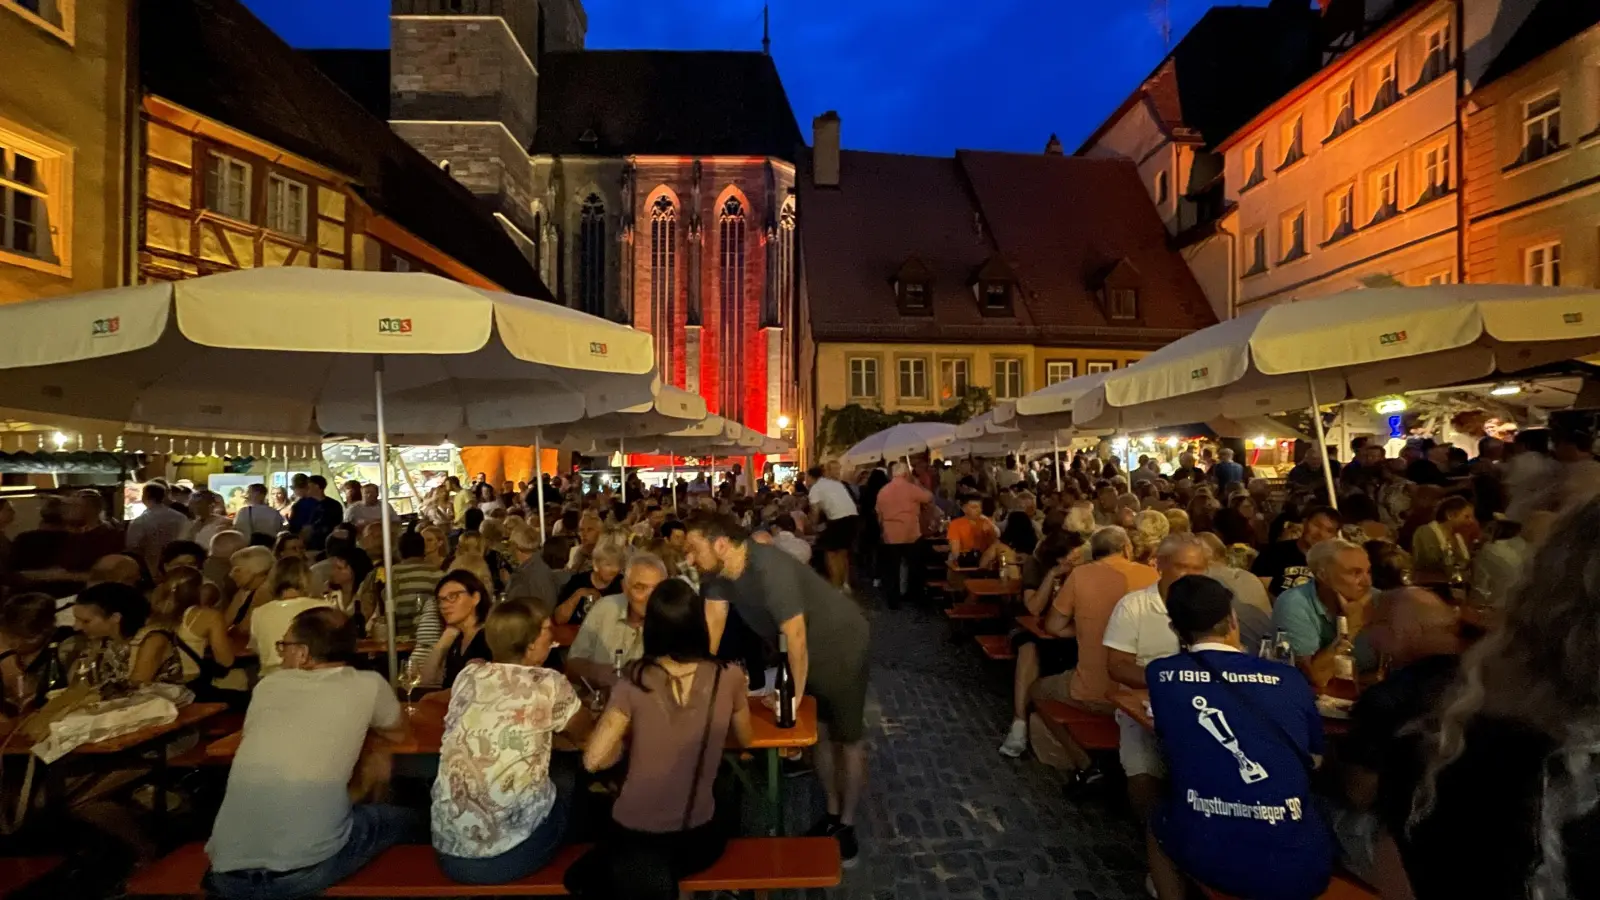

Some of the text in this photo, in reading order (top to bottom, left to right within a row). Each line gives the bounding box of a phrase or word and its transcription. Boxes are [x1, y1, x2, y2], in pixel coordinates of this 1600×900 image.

[93, 317, 119, 334] NGS
[380, 319, 411, 332] NGS
[1381, 331, 1407, 344] NGS
[590, 343, 607, 354] NGS
[1159, 670, 1174, 682] SV
[1179, 670, 1211, 682] 1919
